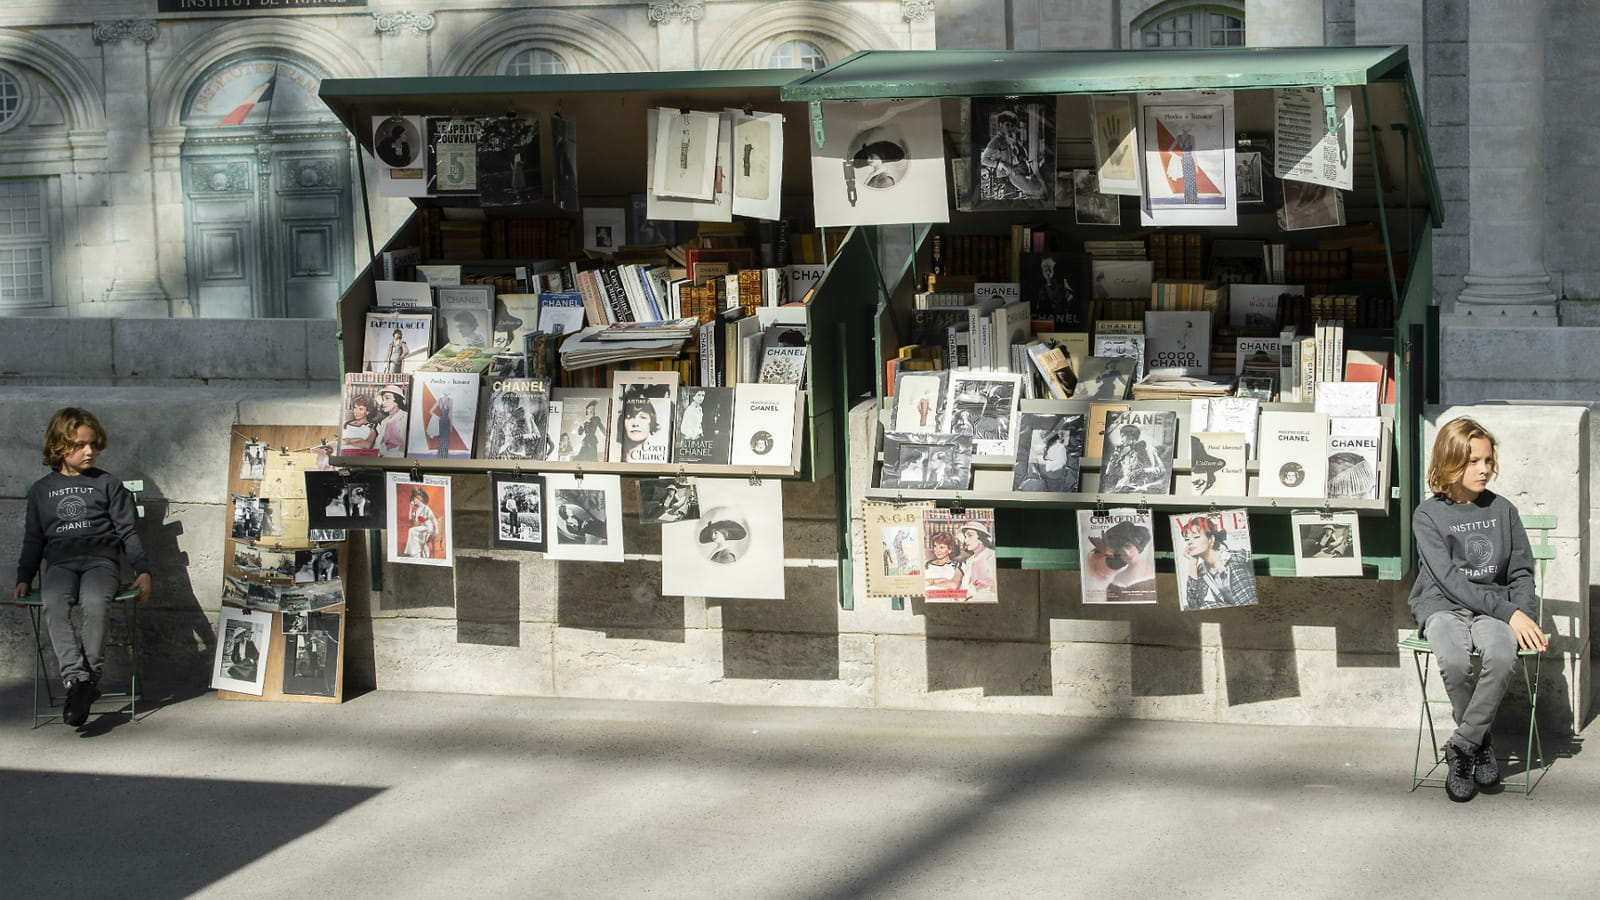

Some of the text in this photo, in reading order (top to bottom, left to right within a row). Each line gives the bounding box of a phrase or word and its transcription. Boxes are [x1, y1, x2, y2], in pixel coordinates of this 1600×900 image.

[447, 152, 465, 184] 5
[792, 270, 822, 280] CHA
[609, 268, 631, 314] Coco Chanel
[977, 287, 1018, 296] CHANEL
[446, 295, 481, 304] CHANEL
[542, 299, 580, 308] CHANEL
[1240, 342, 1281, 350] CHANEL
[768, 348, 805, 356] CHANEL
[1158, 351, 1195, 360] COCO
[1150, 359, 1203, 367] CHANEL
[492, 380, 546, 392] CHANEL
[1278, 434, 1310, 442] CHANEL
[1331, 439, 1377, 448] CHANEL
[680, 448, 713, 456] CHANEL
[48, 486, 94, 498] INSTITUT
[56, 520, 91, 533] CHANEL
[1449, 519, 1497, 533] INSTITUT
